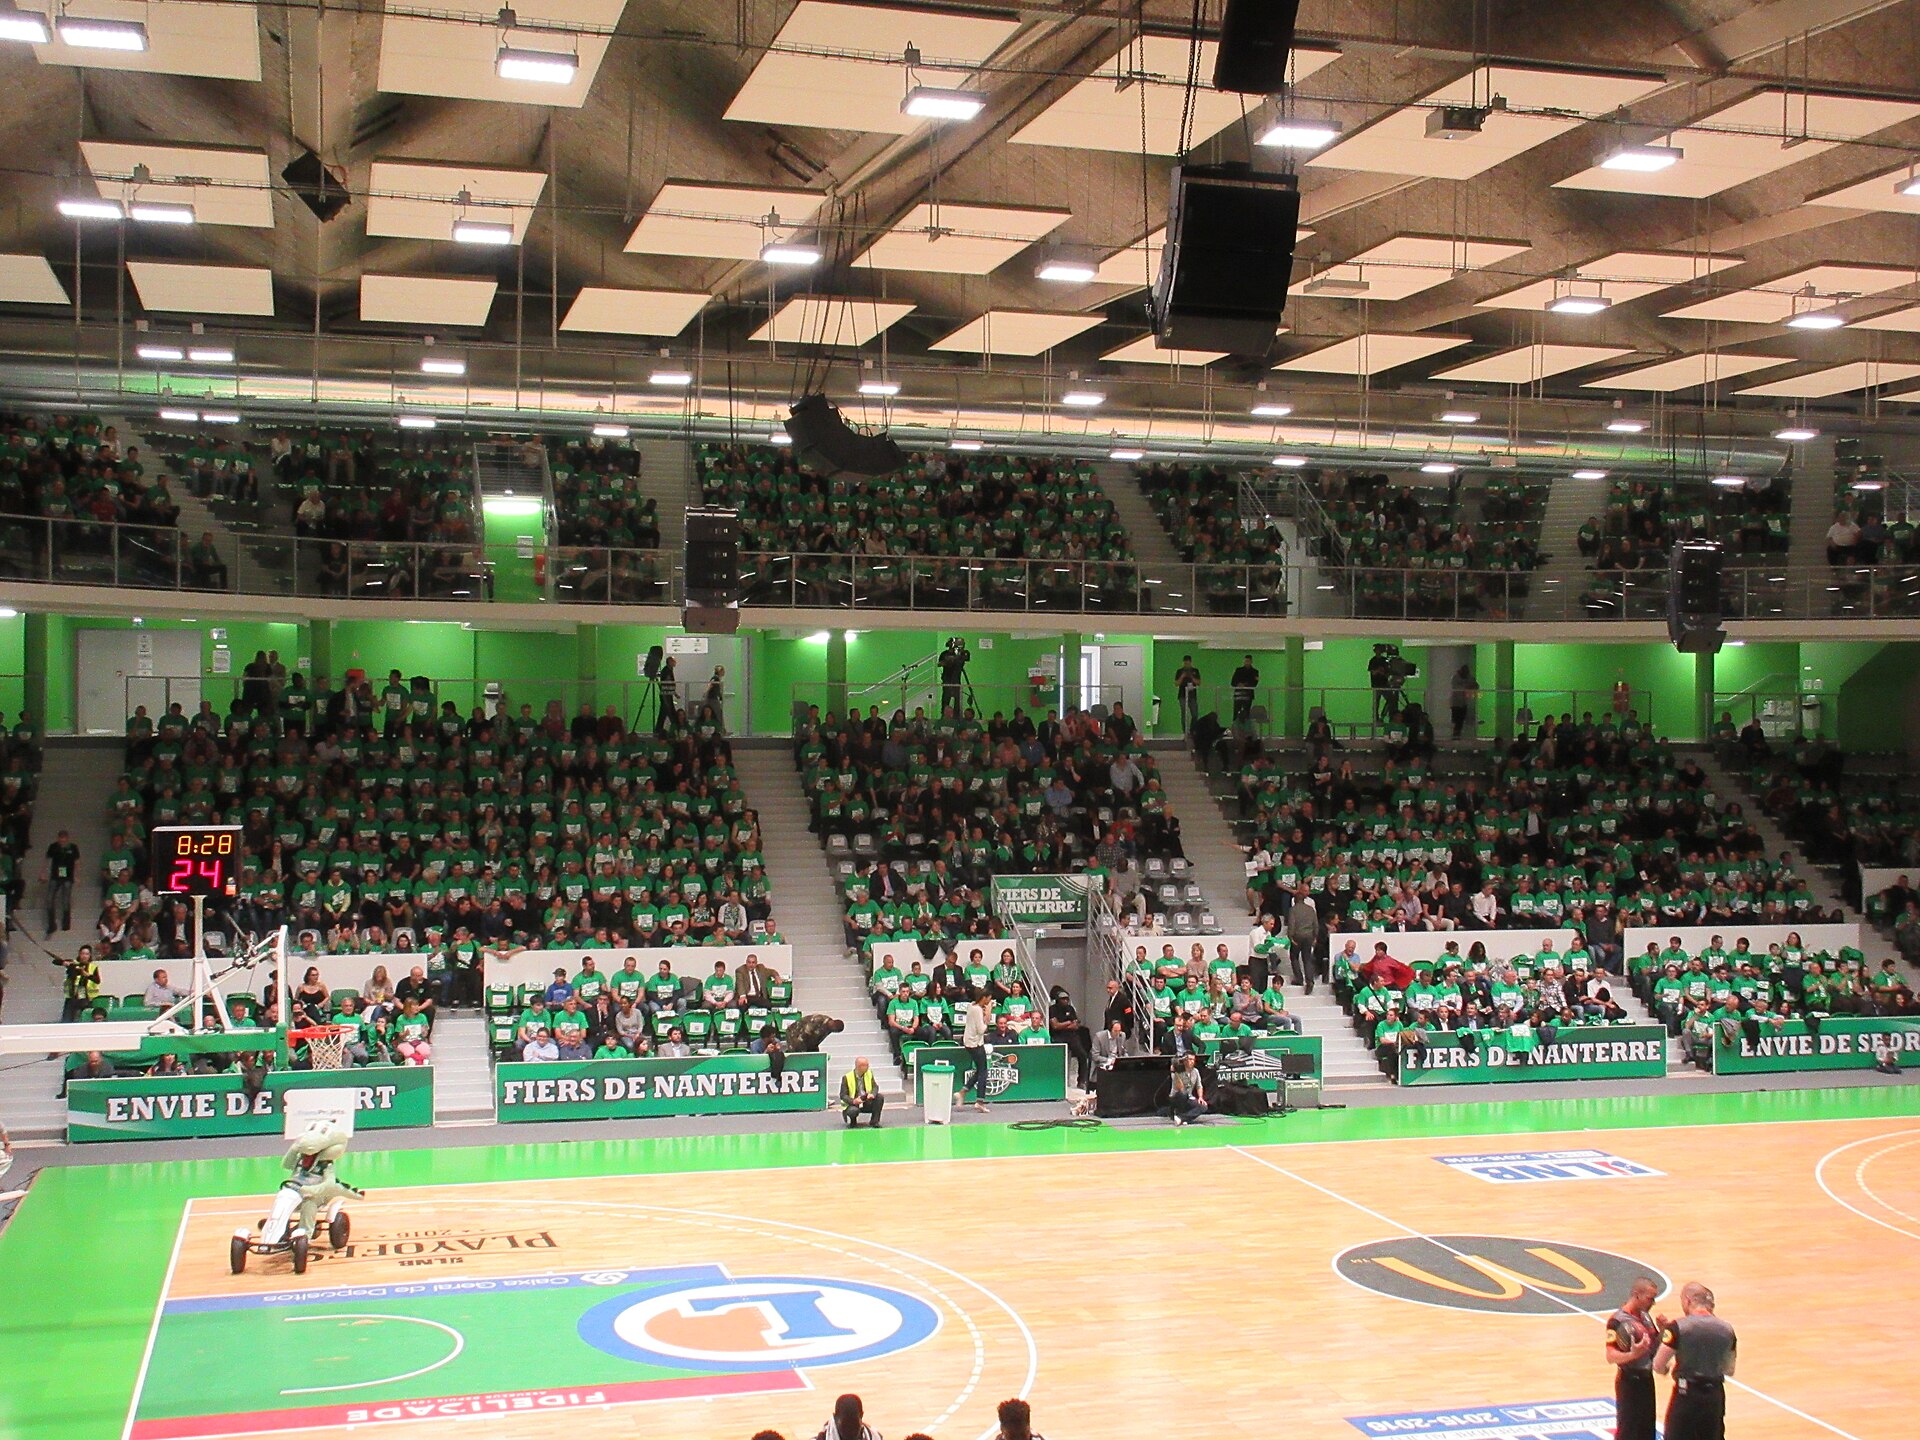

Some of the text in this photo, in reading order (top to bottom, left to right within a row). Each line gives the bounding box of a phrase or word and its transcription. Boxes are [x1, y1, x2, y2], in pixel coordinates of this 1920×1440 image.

[177, 834, 232, 855] 8:28
[171, 860, 220, 890] 24
[999, 887, 1061, 900] FIERS DE
[1406, 1047, 1480, 1069] FIERS
[1527, 1040, 1662, 1066] NANTERRE
[1740, 1035, 1813, 1057] ENVIE
[1819, 1034, 1851, 1054] DE
[1006, 1069, 1017, 1080] 92
[504, 1070, 820, 1104] FIERS DE NANTERRE
[107, 1093, 216, 1122] ENVIE
[226, 1090, 273, 1116] DE
[395, 1283, 425, 1293] de
[432, 1280, 497, 1292] Geral
[503, 1277, 570, 1287] Caixa
[1366, 1411, 1500, 1432] 2015-2016
